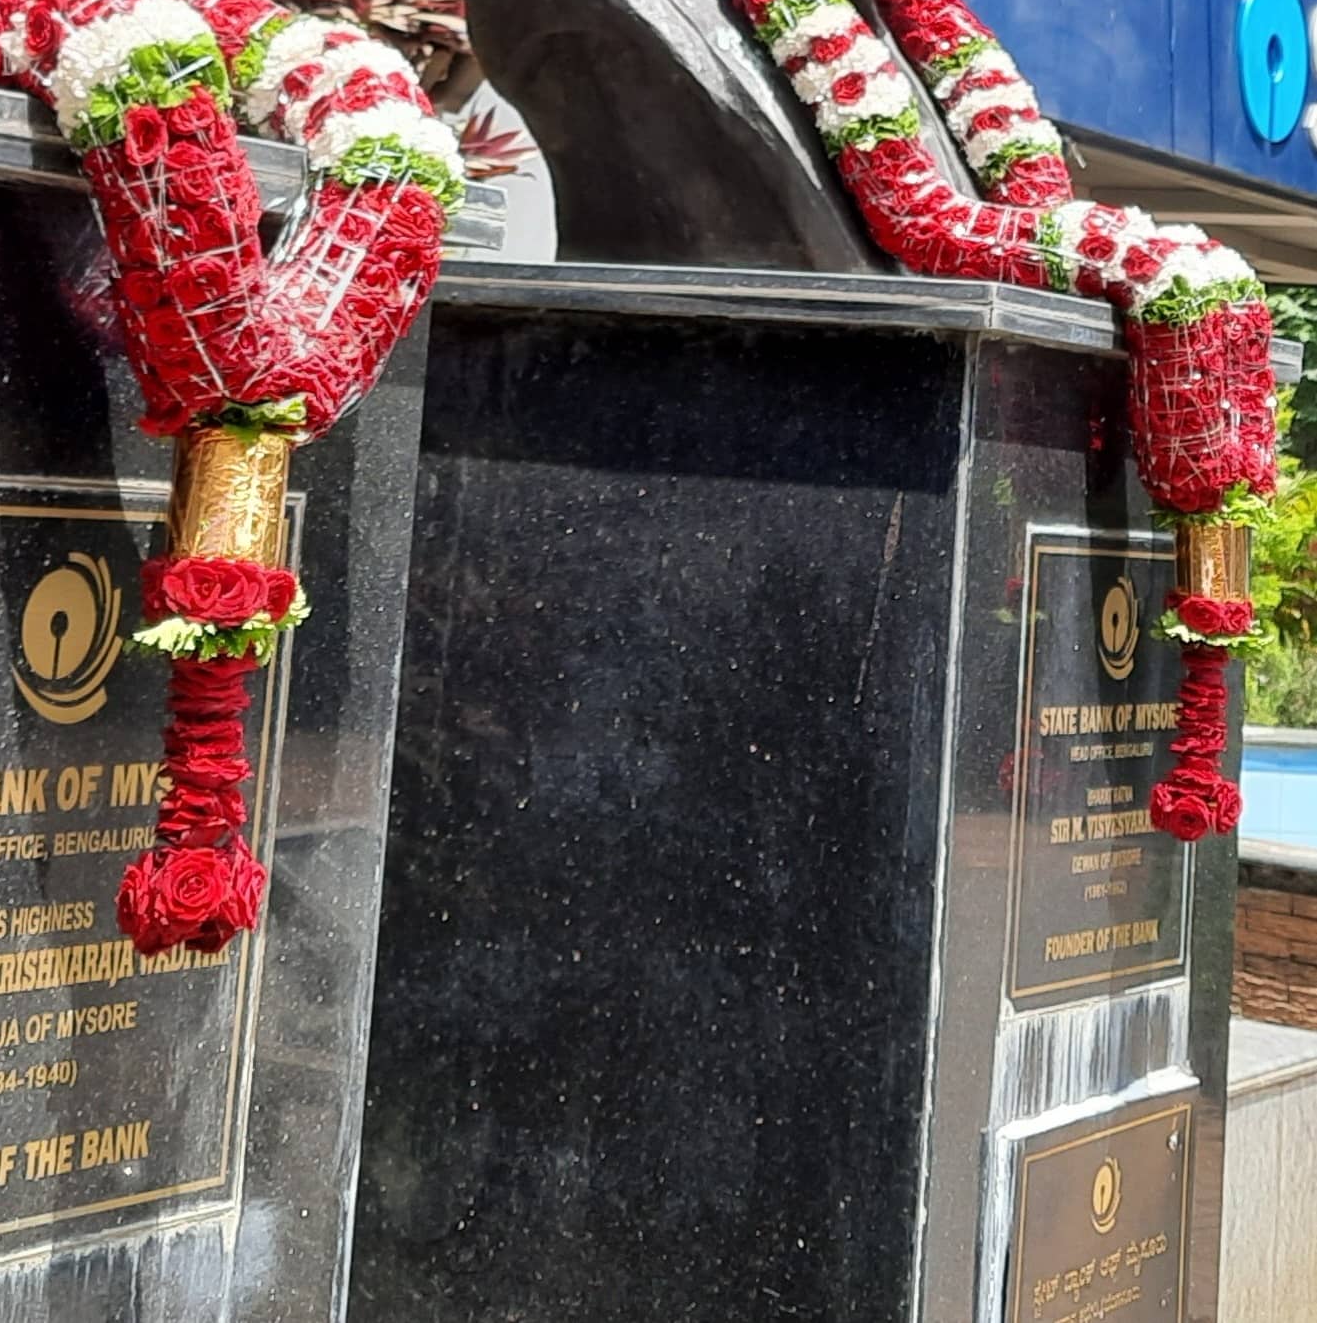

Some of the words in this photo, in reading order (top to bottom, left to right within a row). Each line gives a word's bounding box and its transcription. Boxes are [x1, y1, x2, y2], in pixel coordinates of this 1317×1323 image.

[1039, 706, 1077, 736] STATE
[1079, 705, 1113, 734] BANK
[1115, 704, 1133, 732] OF
[57, 766, 104, 812] OF
[53, 825, 156, 856] BENGALURU
[1050, 818, 1069, 844] SIR
[12, 901, 95, 936] HIGHNESS
[1045, 930, 1094, 962] FOUNDER
[1096, 928, 1111, 952] OF
[1112, 924, 1131, 950] THE
[25, 1015, 54, 1043] OF
[56, 1001, 138, 1036] MYSORE
[25, 1135, 75, 1179] THE
[81, 1121, 152, 1169] BANK
